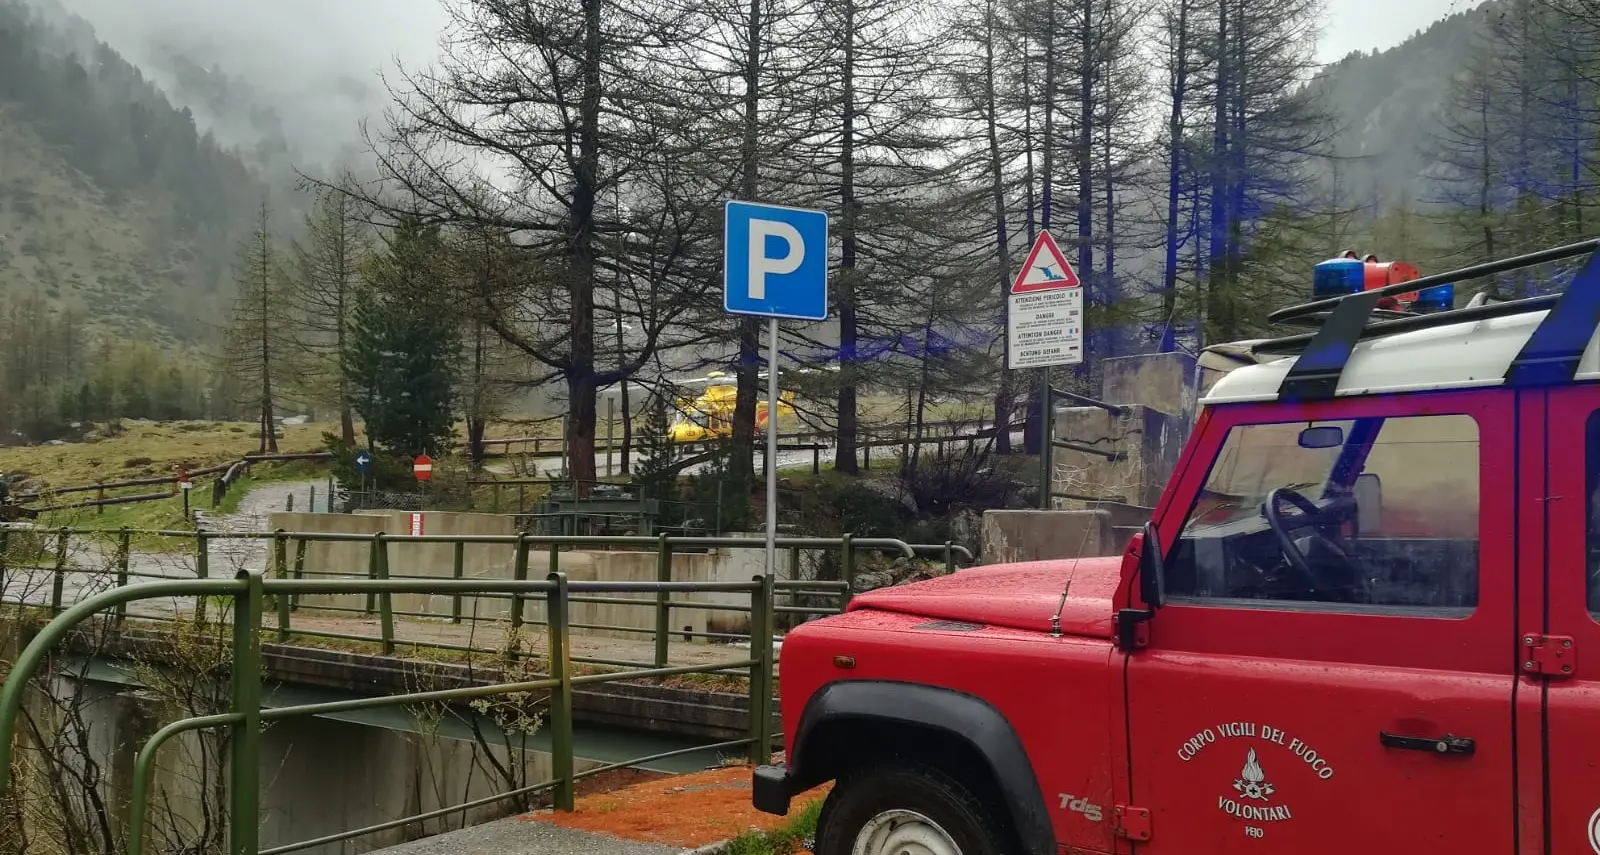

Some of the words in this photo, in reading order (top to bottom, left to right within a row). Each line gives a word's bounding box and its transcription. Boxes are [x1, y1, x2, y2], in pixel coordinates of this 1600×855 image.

[748, 218, 806, 300] P
[1015, 296, 1042, 304] ATTENZIONE
[1035, 312, 1055, 320] DANGER
[1018, 331, 1042, 339] ATTENTION
[1177, 729, 1215, 761] CORPO
[1217, 722, 1256, 738] VIGILI
[1261, 725, 1285, 745] DEL
[1289, 738, 1334, 780] FUOCO
[1058, 793, 1103, 821] Td5
[1218, 795, 1292, 821] VOLONTARI
